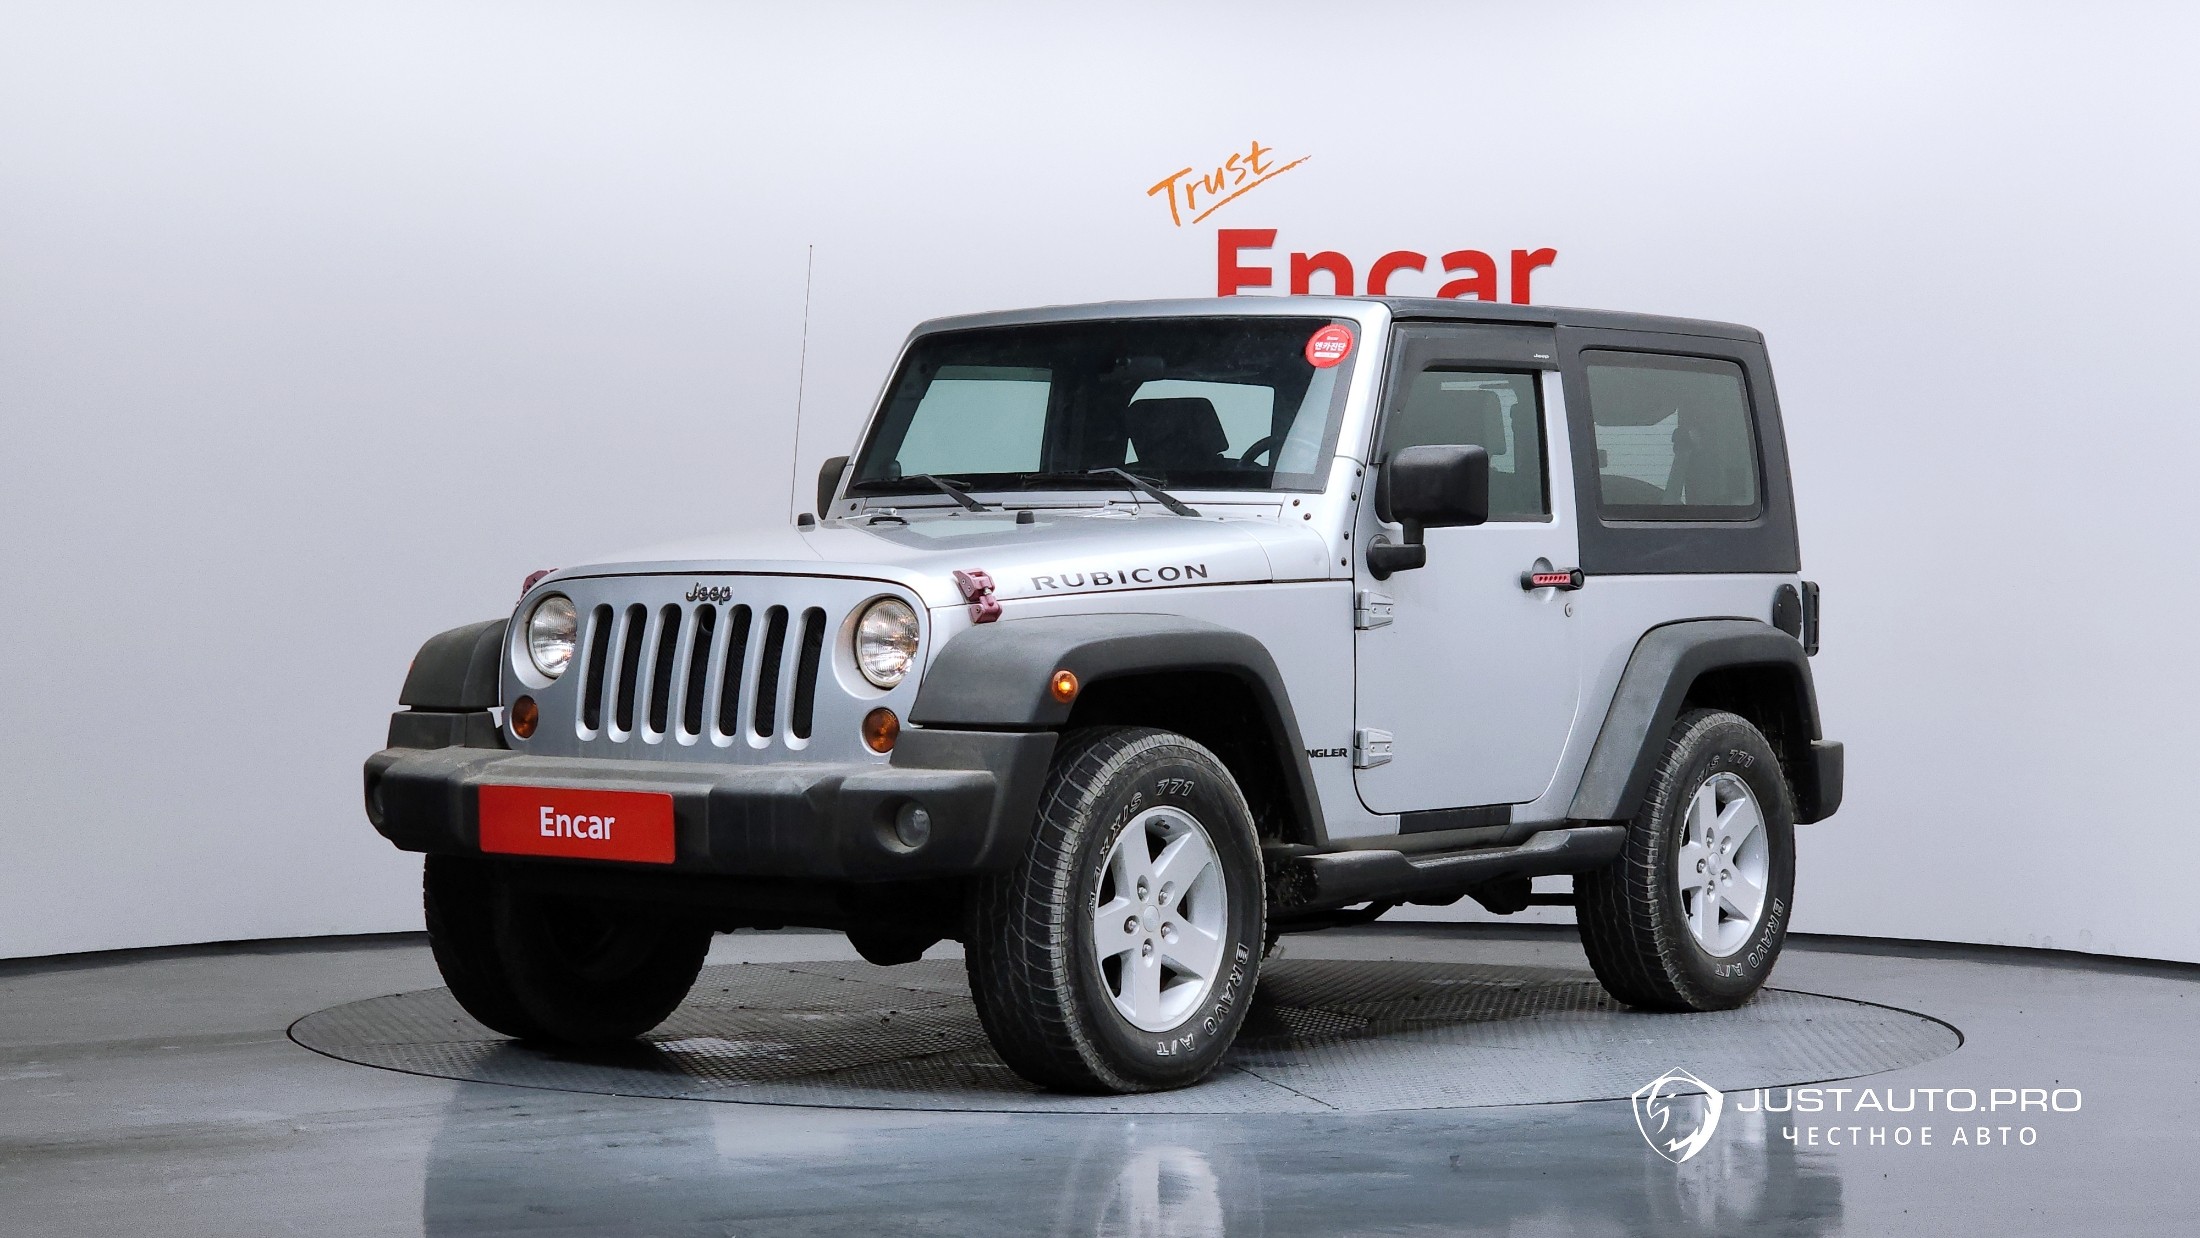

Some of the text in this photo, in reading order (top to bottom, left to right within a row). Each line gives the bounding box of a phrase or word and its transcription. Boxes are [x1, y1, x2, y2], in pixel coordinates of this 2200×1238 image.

[1147, 140, 1273, 226] Trust
[1217, 228, 1558, 305] Encar
[685, 581, 733, 606] Jeep
[1031, 563, 1209, 591] RUBICON
[1728, 748, 1755, 768] 771
[1156, 778, 1195, 797] 771
[539, 806, 616, 840] Encar
[1714, 897, 1785, 978] BRAVO A/T
[1156, 942, 1250, 1056] BRAVO A/T
